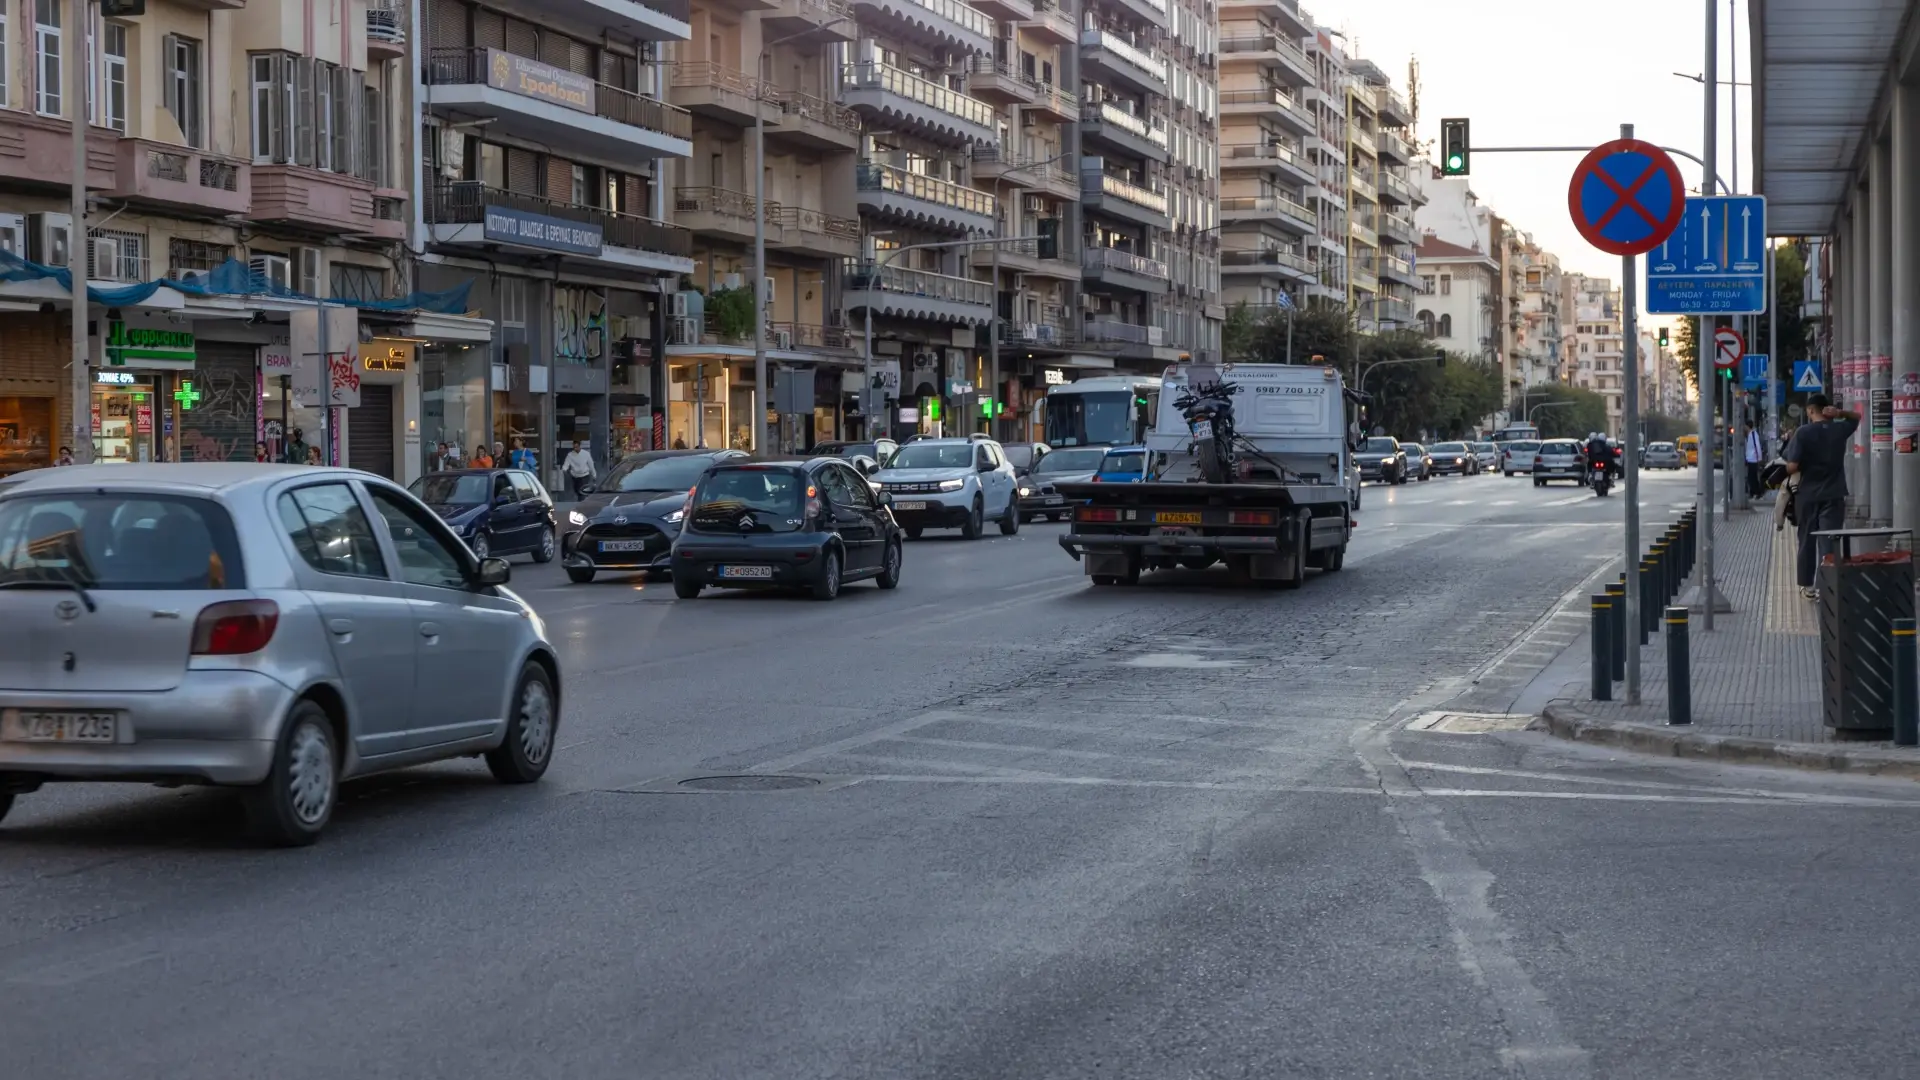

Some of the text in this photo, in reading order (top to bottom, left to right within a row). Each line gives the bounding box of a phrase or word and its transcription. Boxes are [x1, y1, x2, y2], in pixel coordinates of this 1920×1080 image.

[1669, 291, 1703, 299] MONDAY
[1712, 291, 1741, 299] FRIDAY
[266, 354, 291, 367] BRAN
[1256, 386, 1280, 394] 6987
